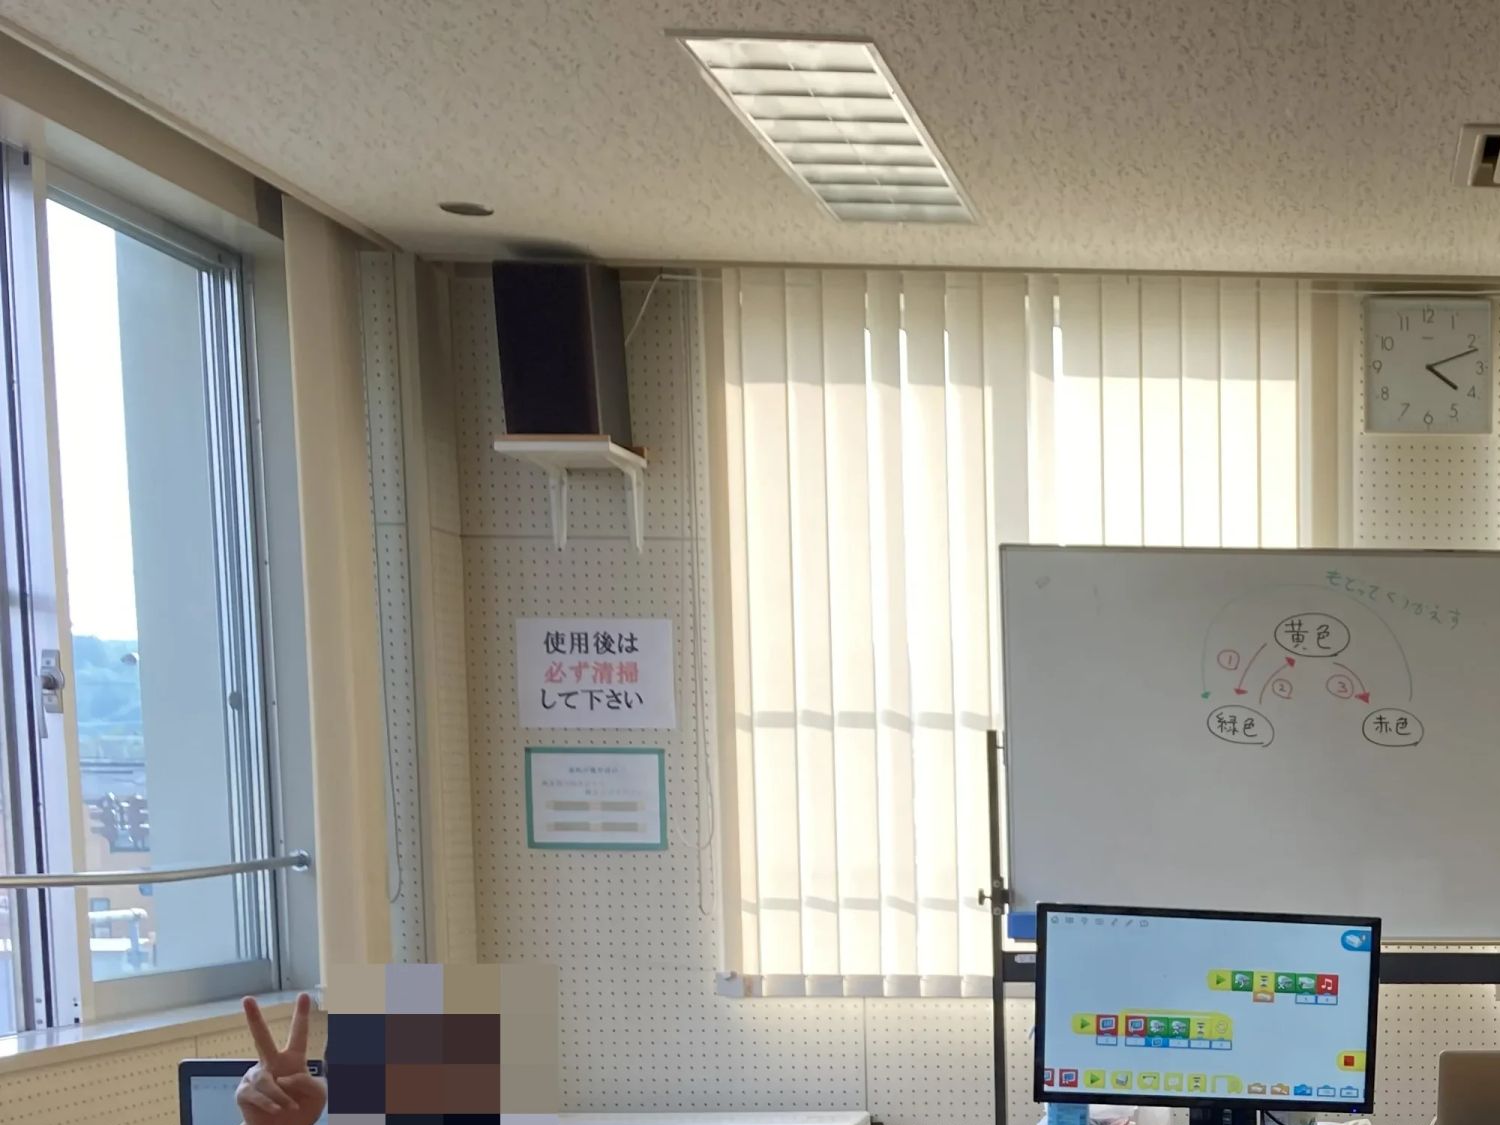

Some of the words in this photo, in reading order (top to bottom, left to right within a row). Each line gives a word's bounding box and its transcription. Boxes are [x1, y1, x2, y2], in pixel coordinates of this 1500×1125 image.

[1399, 315, 1409, 331] 11
[1422, 308, 1435, 324] 12
[1381, 336, 1394, 351] 10
[1467, 334, 1476, 349] 2
[1372, 360, 1382, 374] 9
[1475, 361, 1484, 375] 3
[1381, 386, 1389, 400] 8
[1467, 385, 1476, 398] 4
[1401, 402, 1410, 417] 7
[1450, 403, 1459, 418] 5
[1423, 411, 1434, 425] 6
[1284, 619, 1332, 650] 黄色
[543, 631, 640, 655] 使用後は
[543, 661, 639, 684] 必ず清掃
[541, 689, 644, 711] して下さい
[1216, 711, 1259, 737] 緑色
[1373, 715, 1412, 736] 赤色
